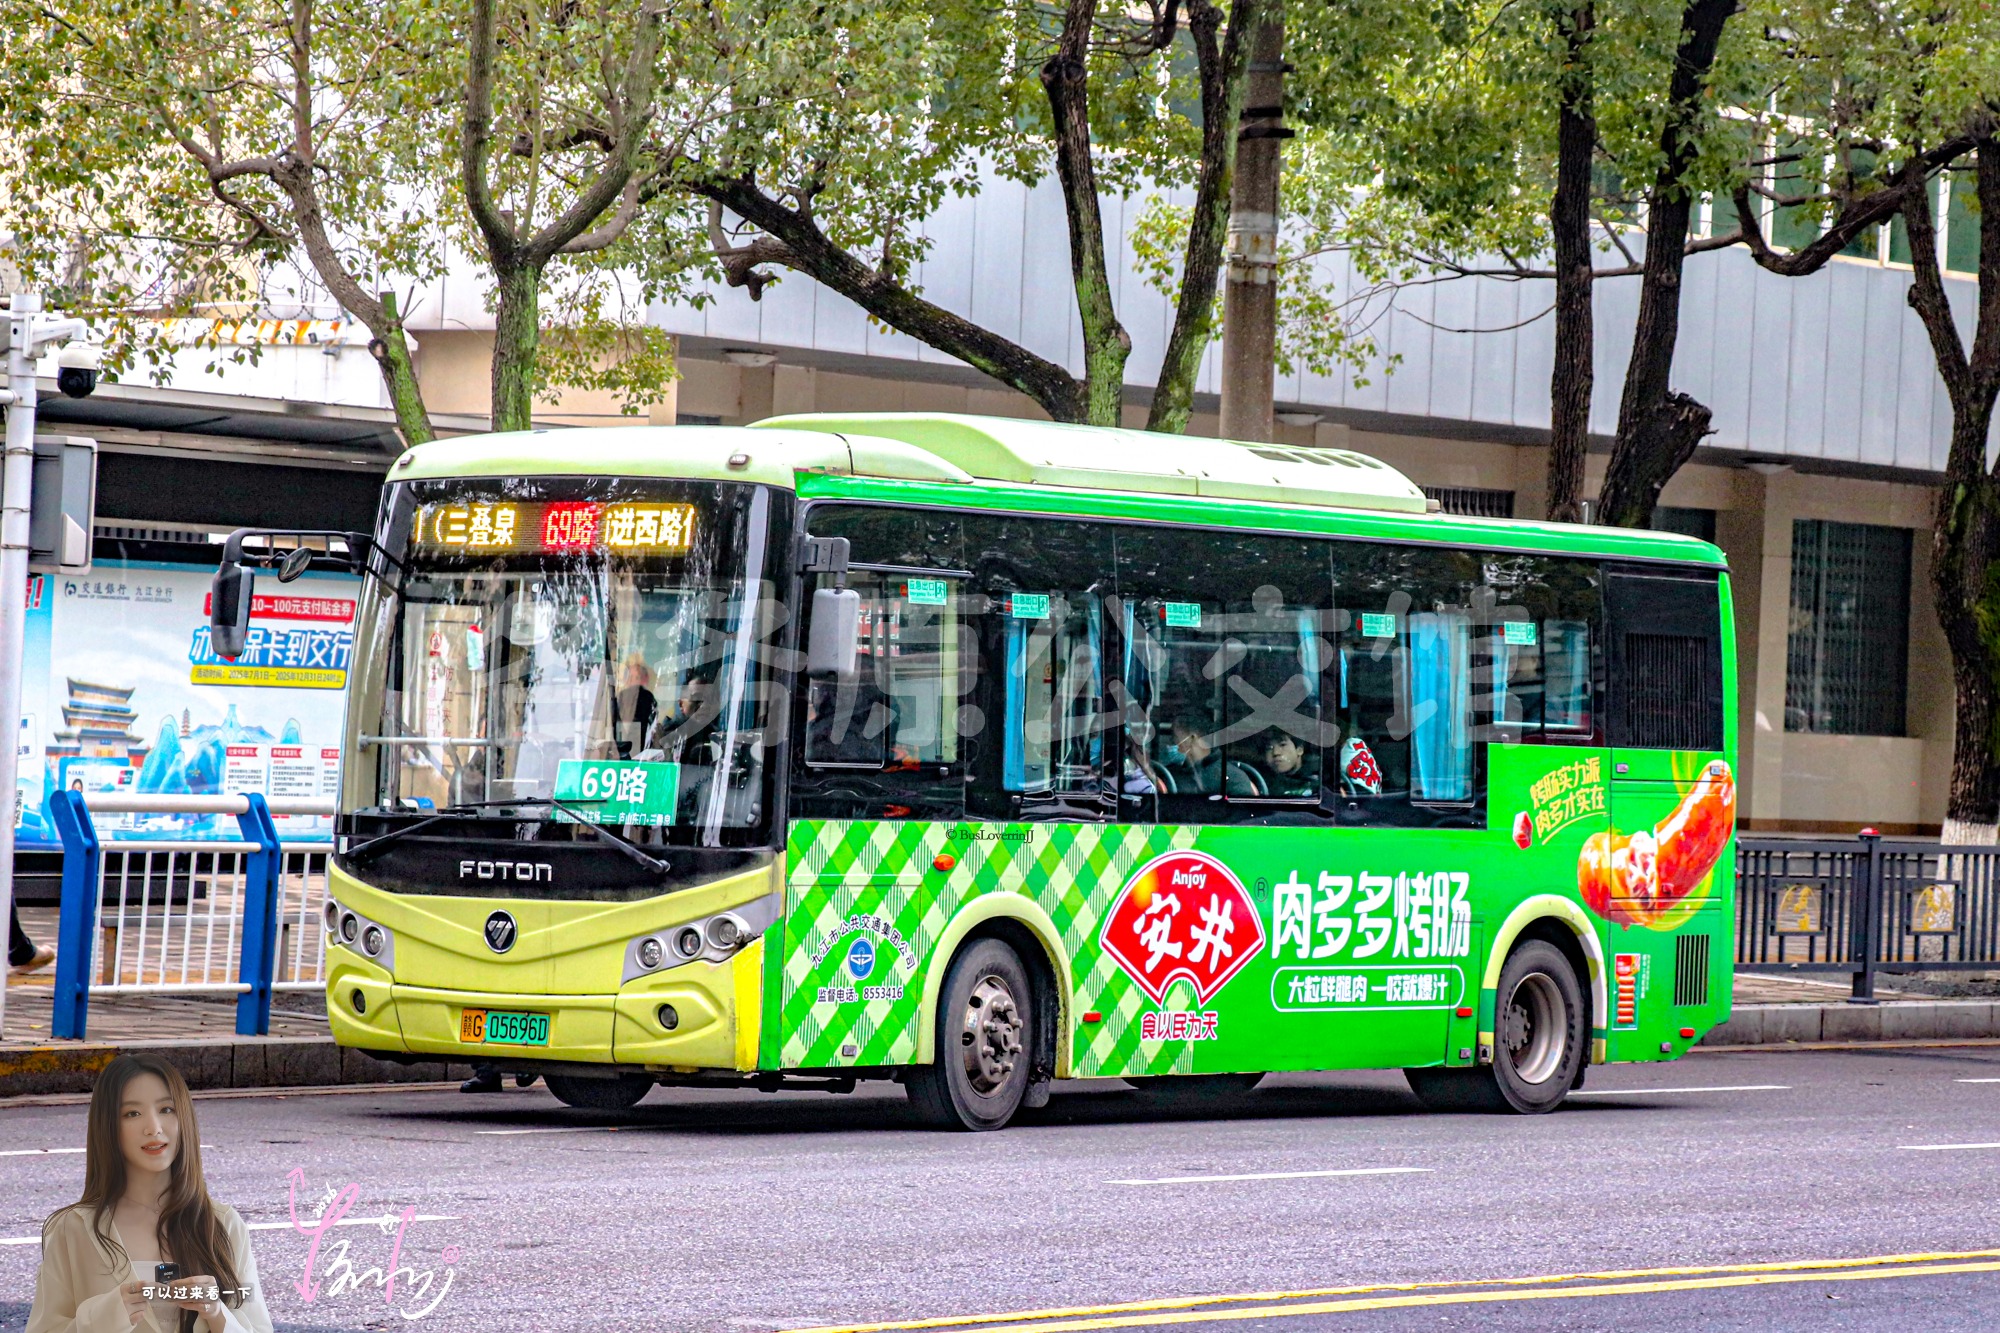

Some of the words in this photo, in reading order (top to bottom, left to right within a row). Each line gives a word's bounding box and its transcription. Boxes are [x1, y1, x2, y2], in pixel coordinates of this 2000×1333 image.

[546, 508, 595, 546] 69路
[81, 581, 127, 595] 交通银行
[135, 586, 173, 598] 九江分行
[190, 628, 352, 667] 办保卡到交行
[582, 766, 648, 805] 69路
[1530, 756, 1601, 810] 烤肠实力派
[1535, 784, 1605, 838] 肉多才实在
[459, 860, 553, 882] FOTON
[1172, 866, 1207, 889] Anjoy
[1132, 893, 1235, 974] 安井
[1271, 870, 1471, 959] 肉多多烤肠
[811, 915, 916, 971] 九江市公共交通集团公司
[863, 986, 903, 1000] 8553416
[1288, 975, 1368, 1004] 大粒鲜腿肉
[1370, 974, 1449, 1002] 一咬就爆汁
[1141, 1011, 1218, 1040] 食以民为天
